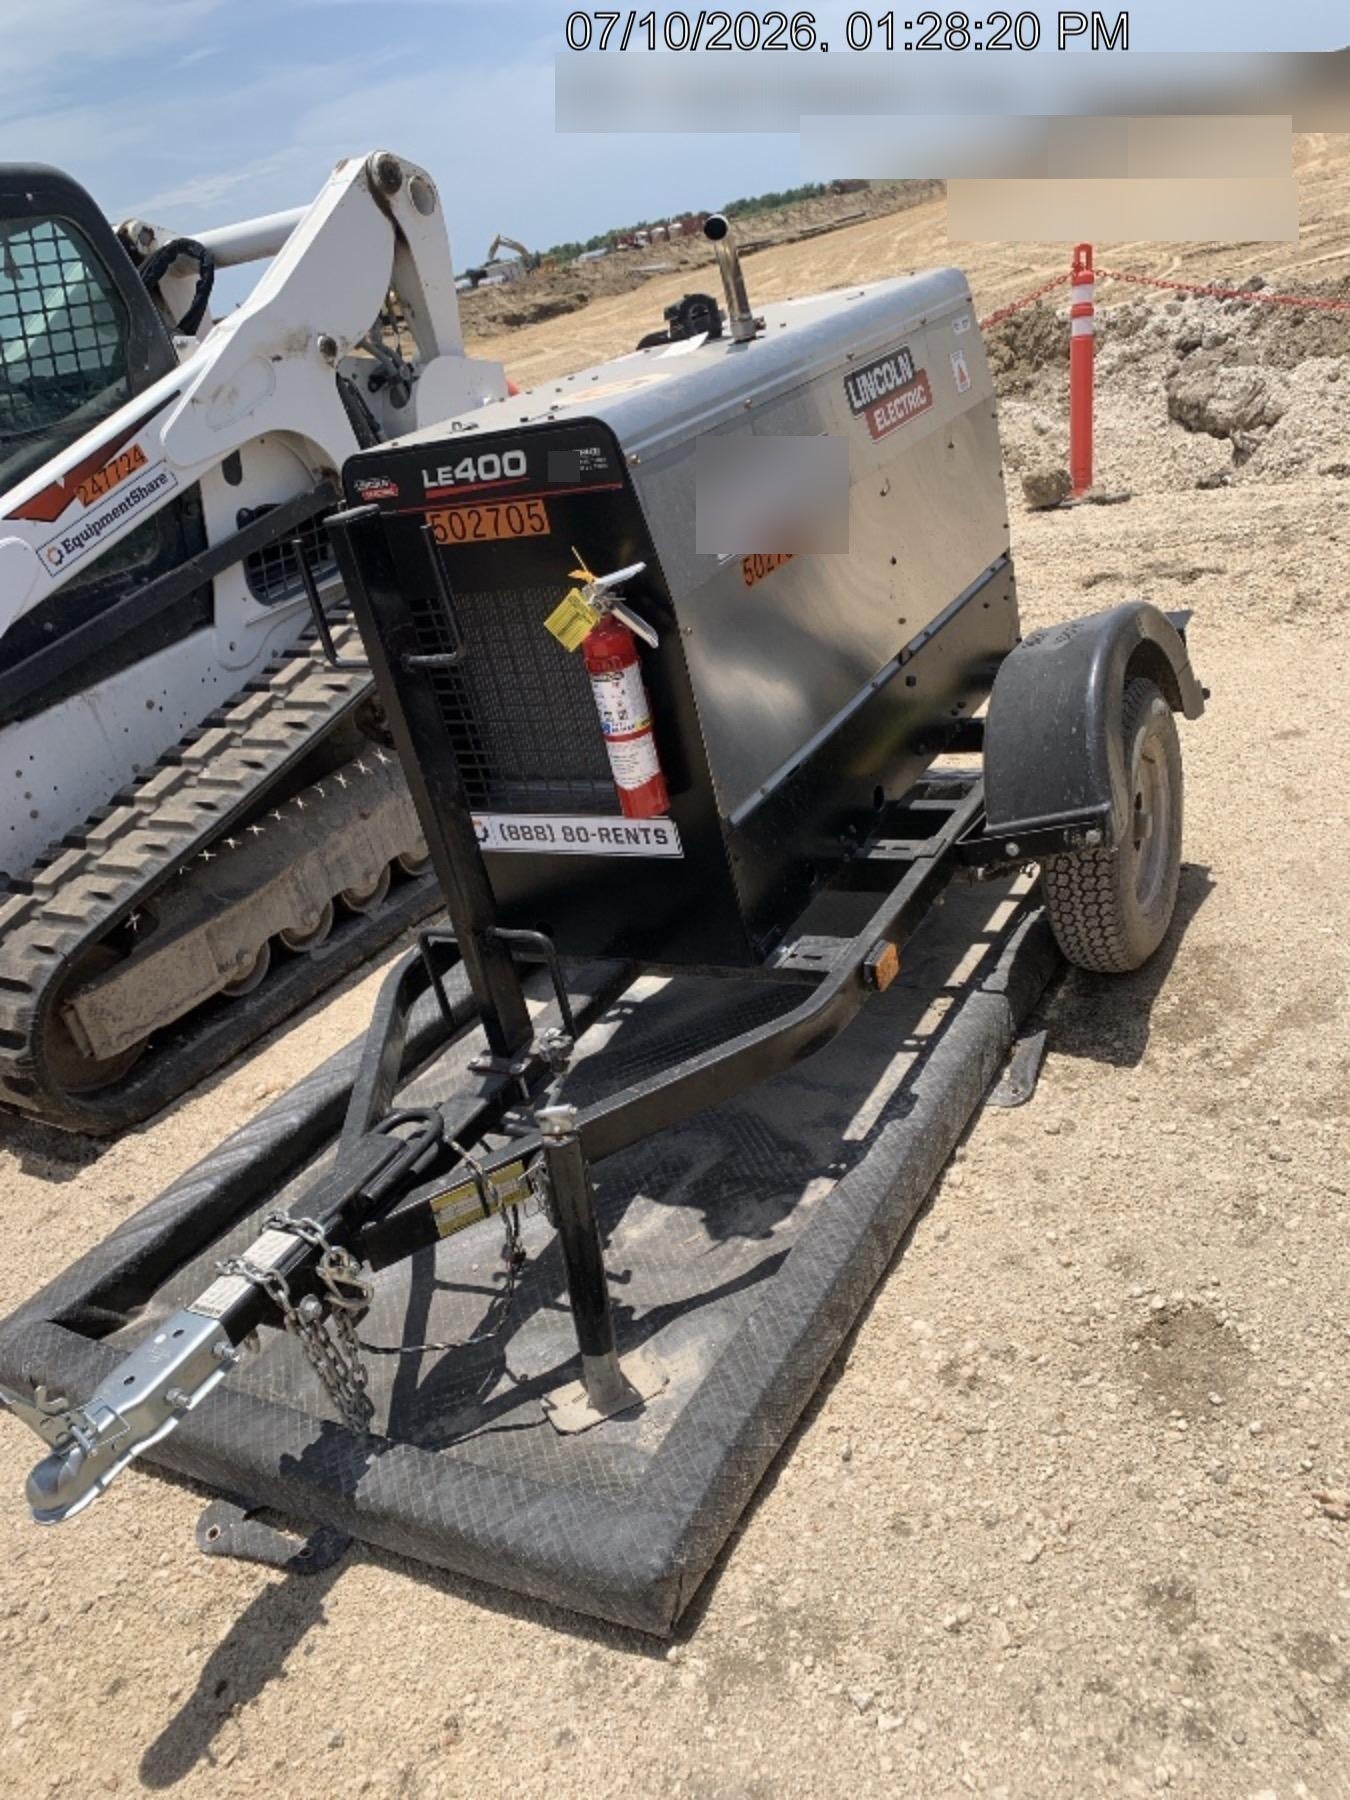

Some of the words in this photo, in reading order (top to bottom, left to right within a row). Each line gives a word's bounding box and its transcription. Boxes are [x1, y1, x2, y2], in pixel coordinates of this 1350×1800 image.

[848, 350, 914, 409] LINCOLN
[873, 385, 928, 431] ELECTRIC
[76, 445, 146, 504] 247724
[421, 450, 527, 488] LE400
[62, 471, 169, 554] EquipmentShare
[430, 502, 545, 542] 502705
[500, 823, 554, 843] (888)
[562, 826, 668, 845] 80-RENTS
